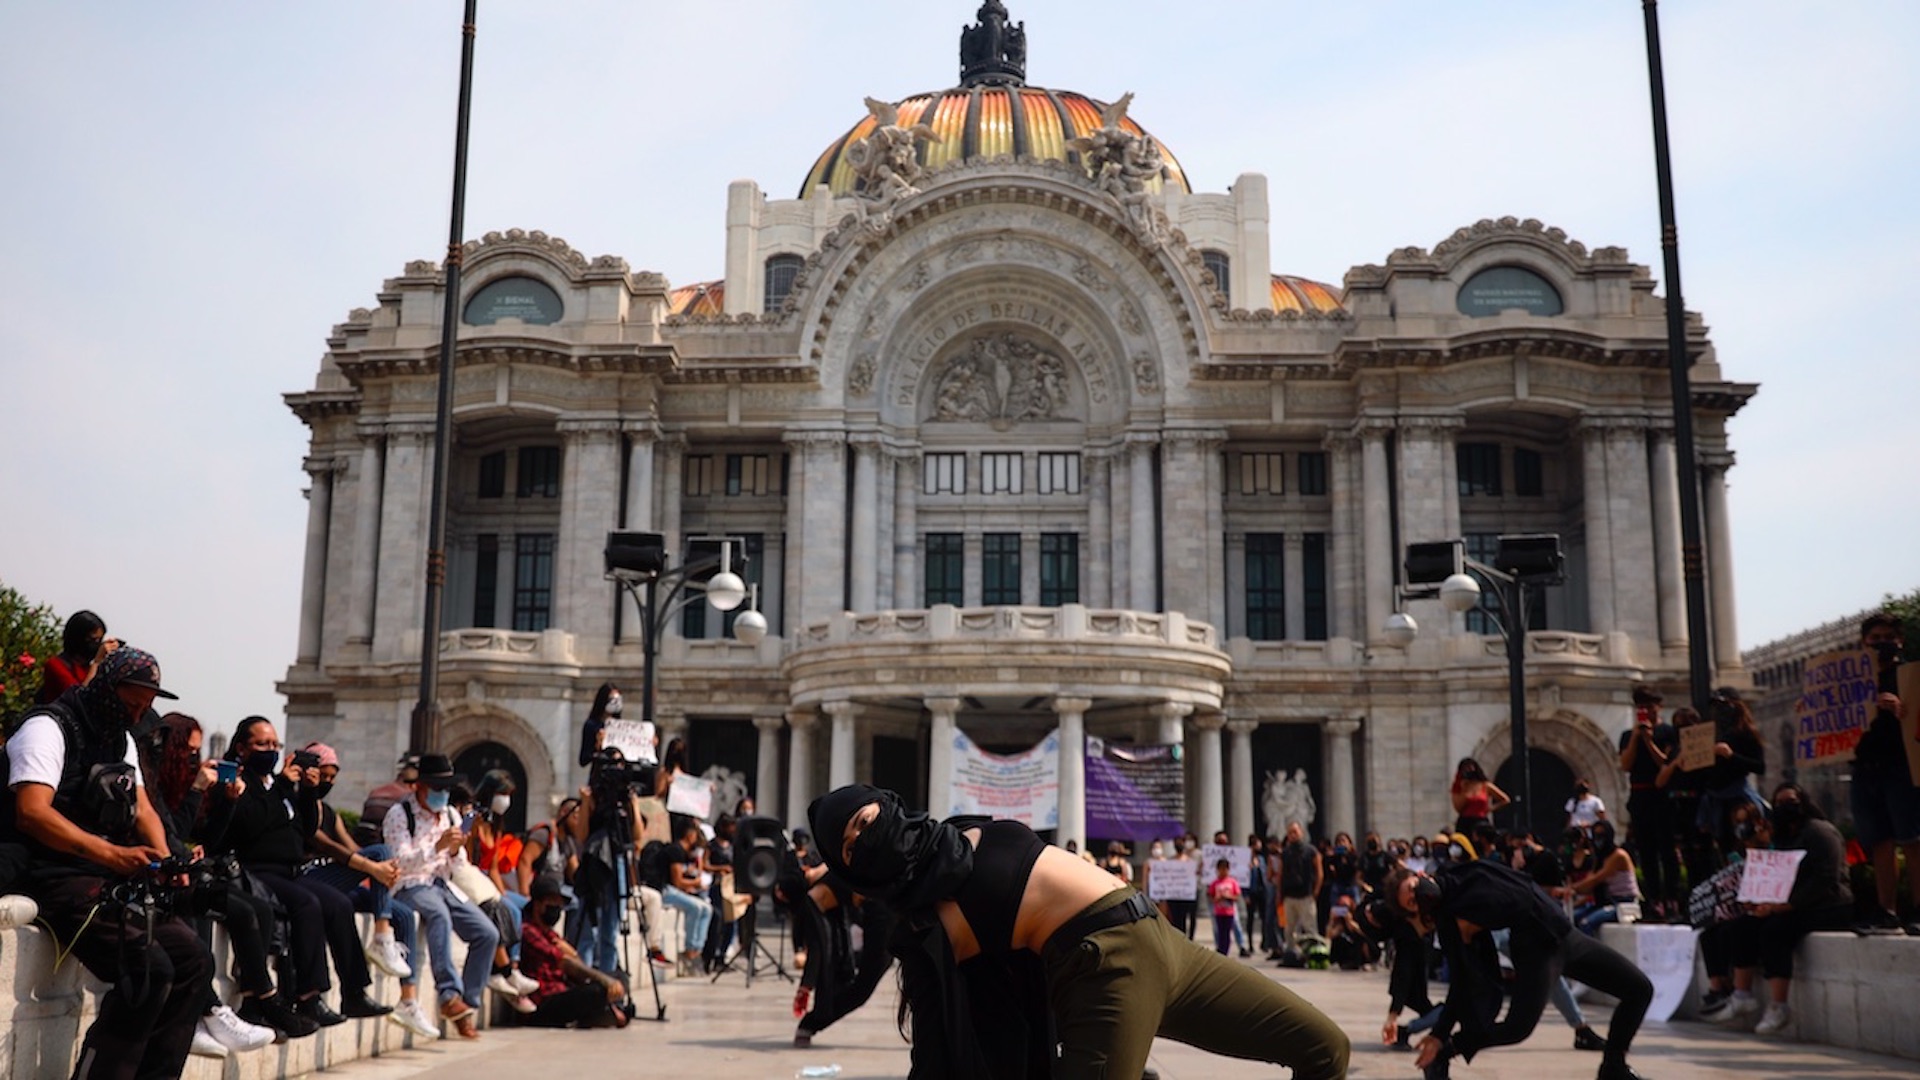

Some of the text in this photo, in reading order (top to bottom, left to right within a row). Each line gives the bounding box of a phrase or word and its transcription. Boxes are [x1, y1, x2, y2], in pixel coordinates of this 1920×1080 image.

[897, 302, 1108, 406] PALACIO DE BELLAS ARTES
[1816, 653, 1873, 685] ESCUELA
[1839, 679, 1878, 706] CUIDA
[1816, 704, 1868, 732] ESCUELA
